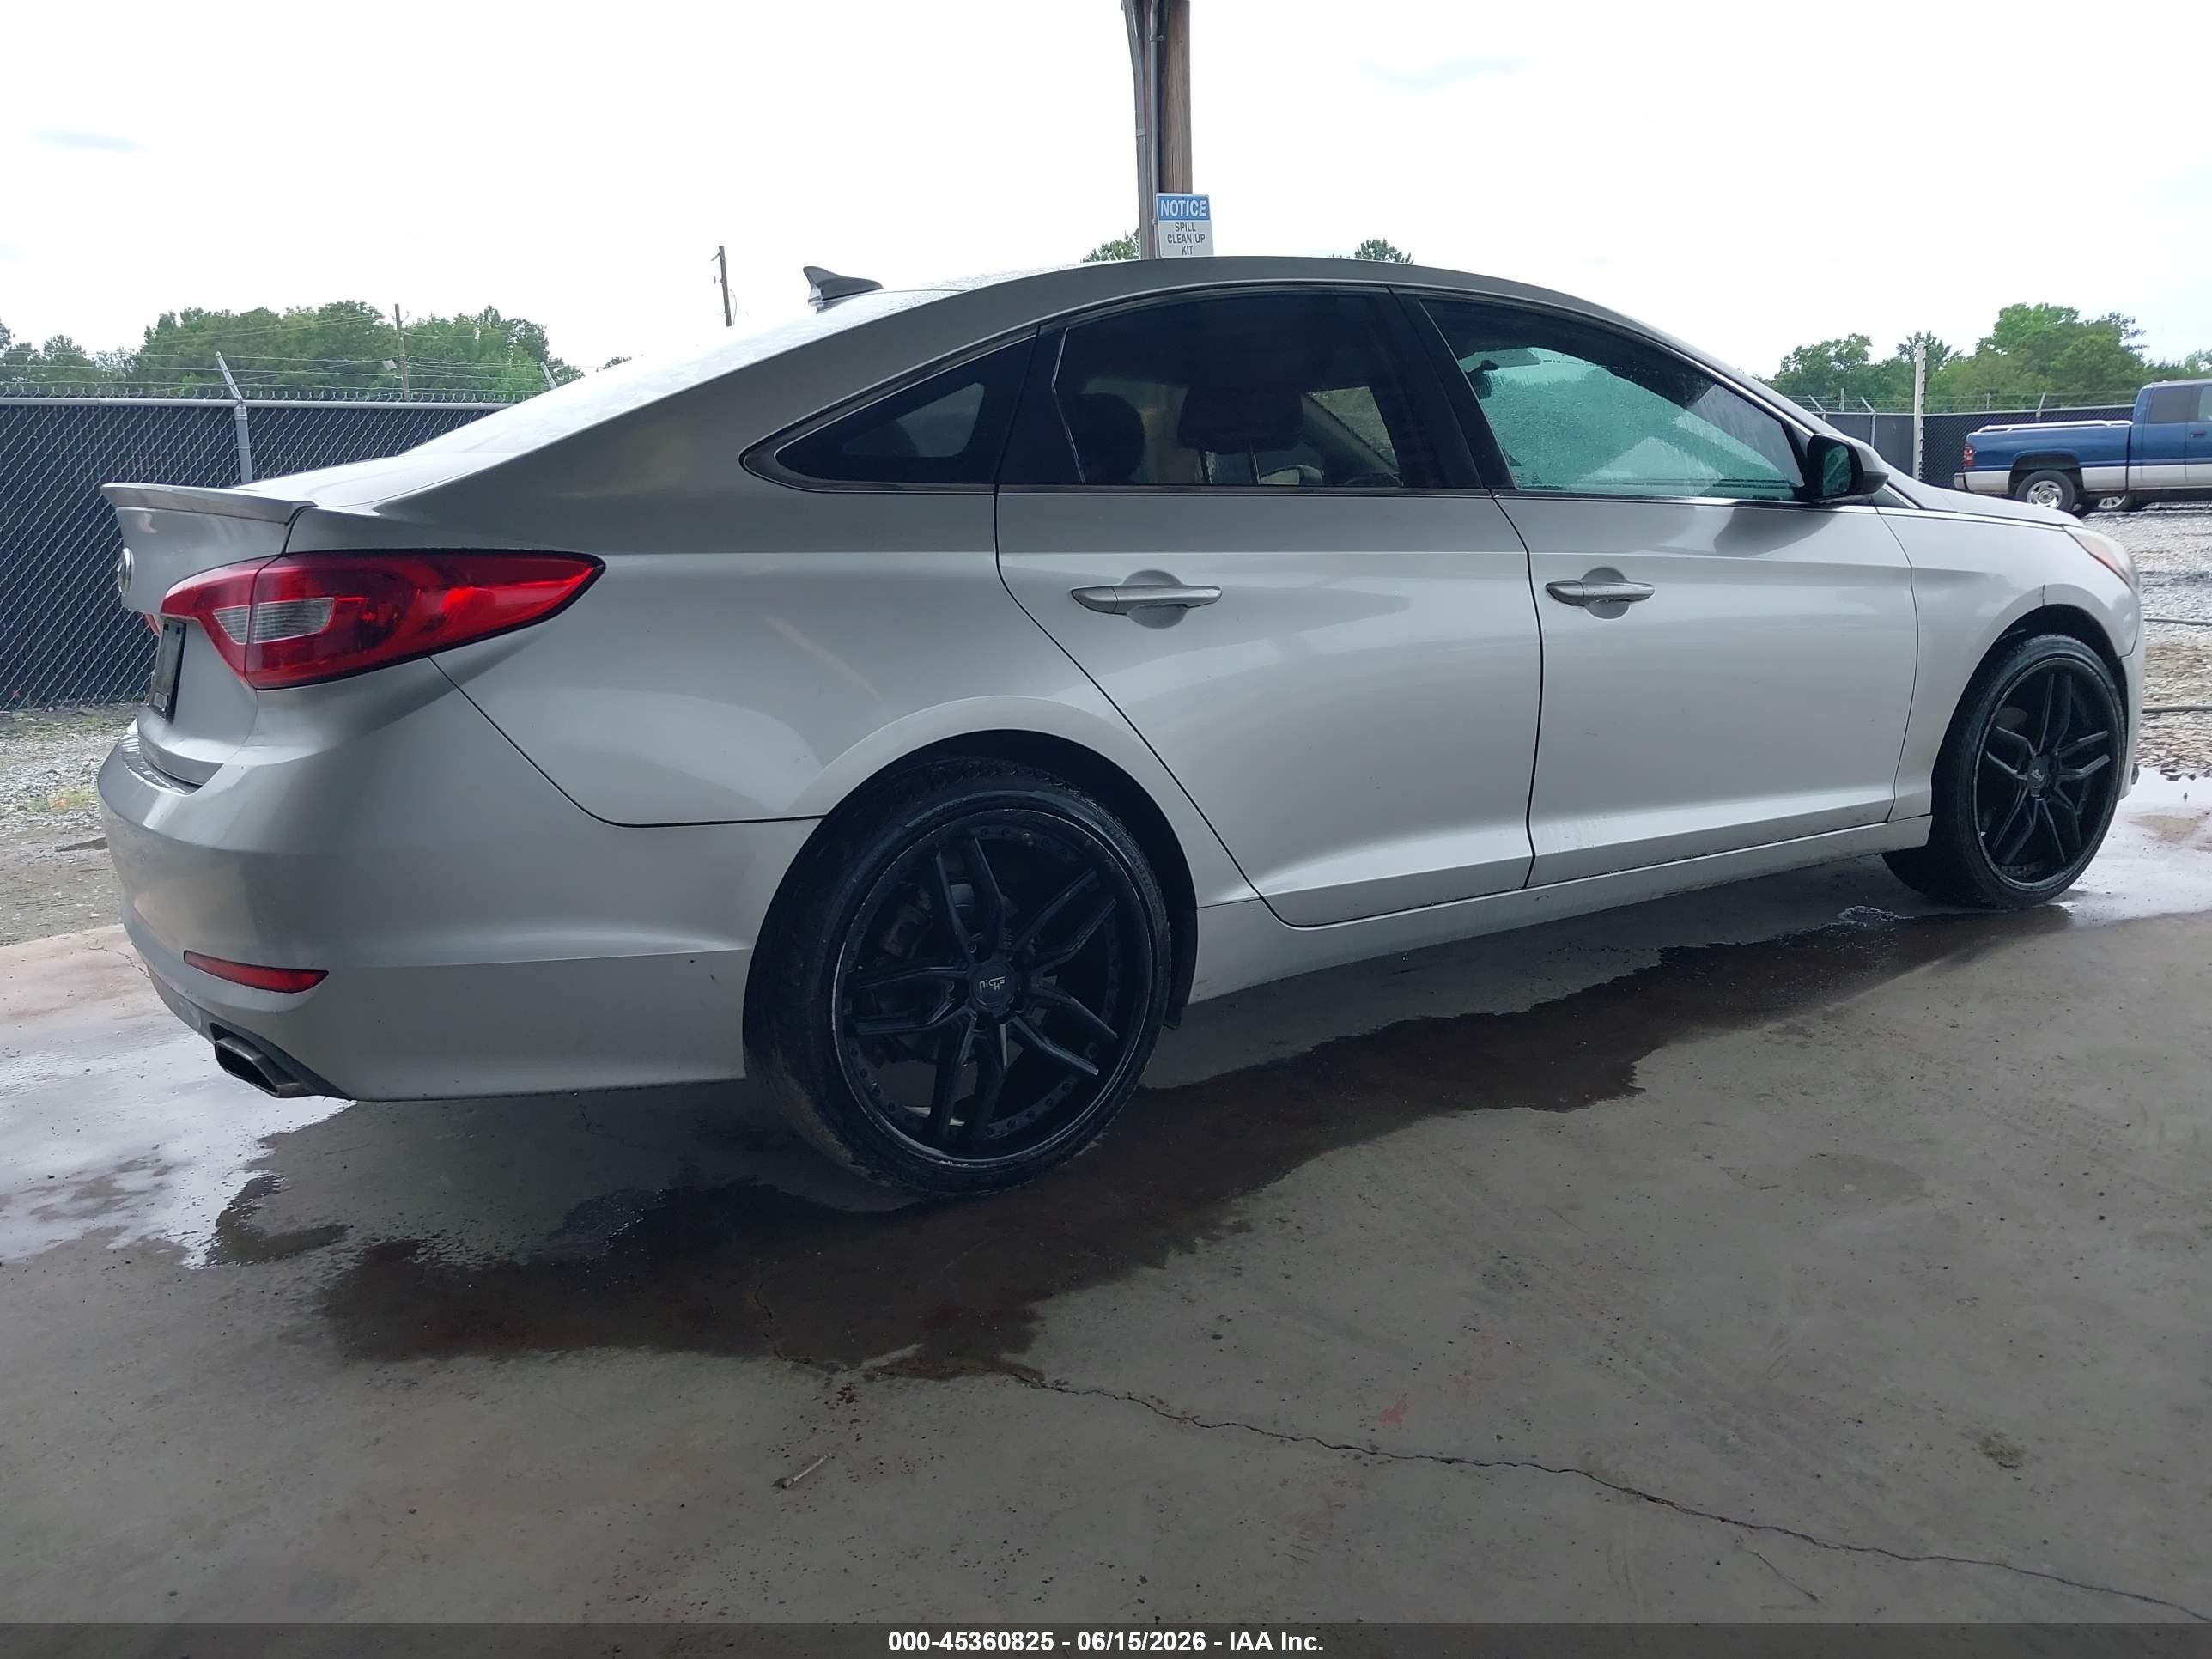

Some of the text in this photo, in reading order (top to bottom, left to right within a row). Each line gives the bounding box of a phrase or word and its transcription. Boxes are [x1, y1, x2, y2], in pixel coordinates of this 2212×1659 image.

[1160, 199, 1207, 216] NOTICE
[1175, 222, 1196, 232] SPILL
[1168, 233, 1206, 244] CLEAN UP
[1182, 245, 1194, 255] KIT
